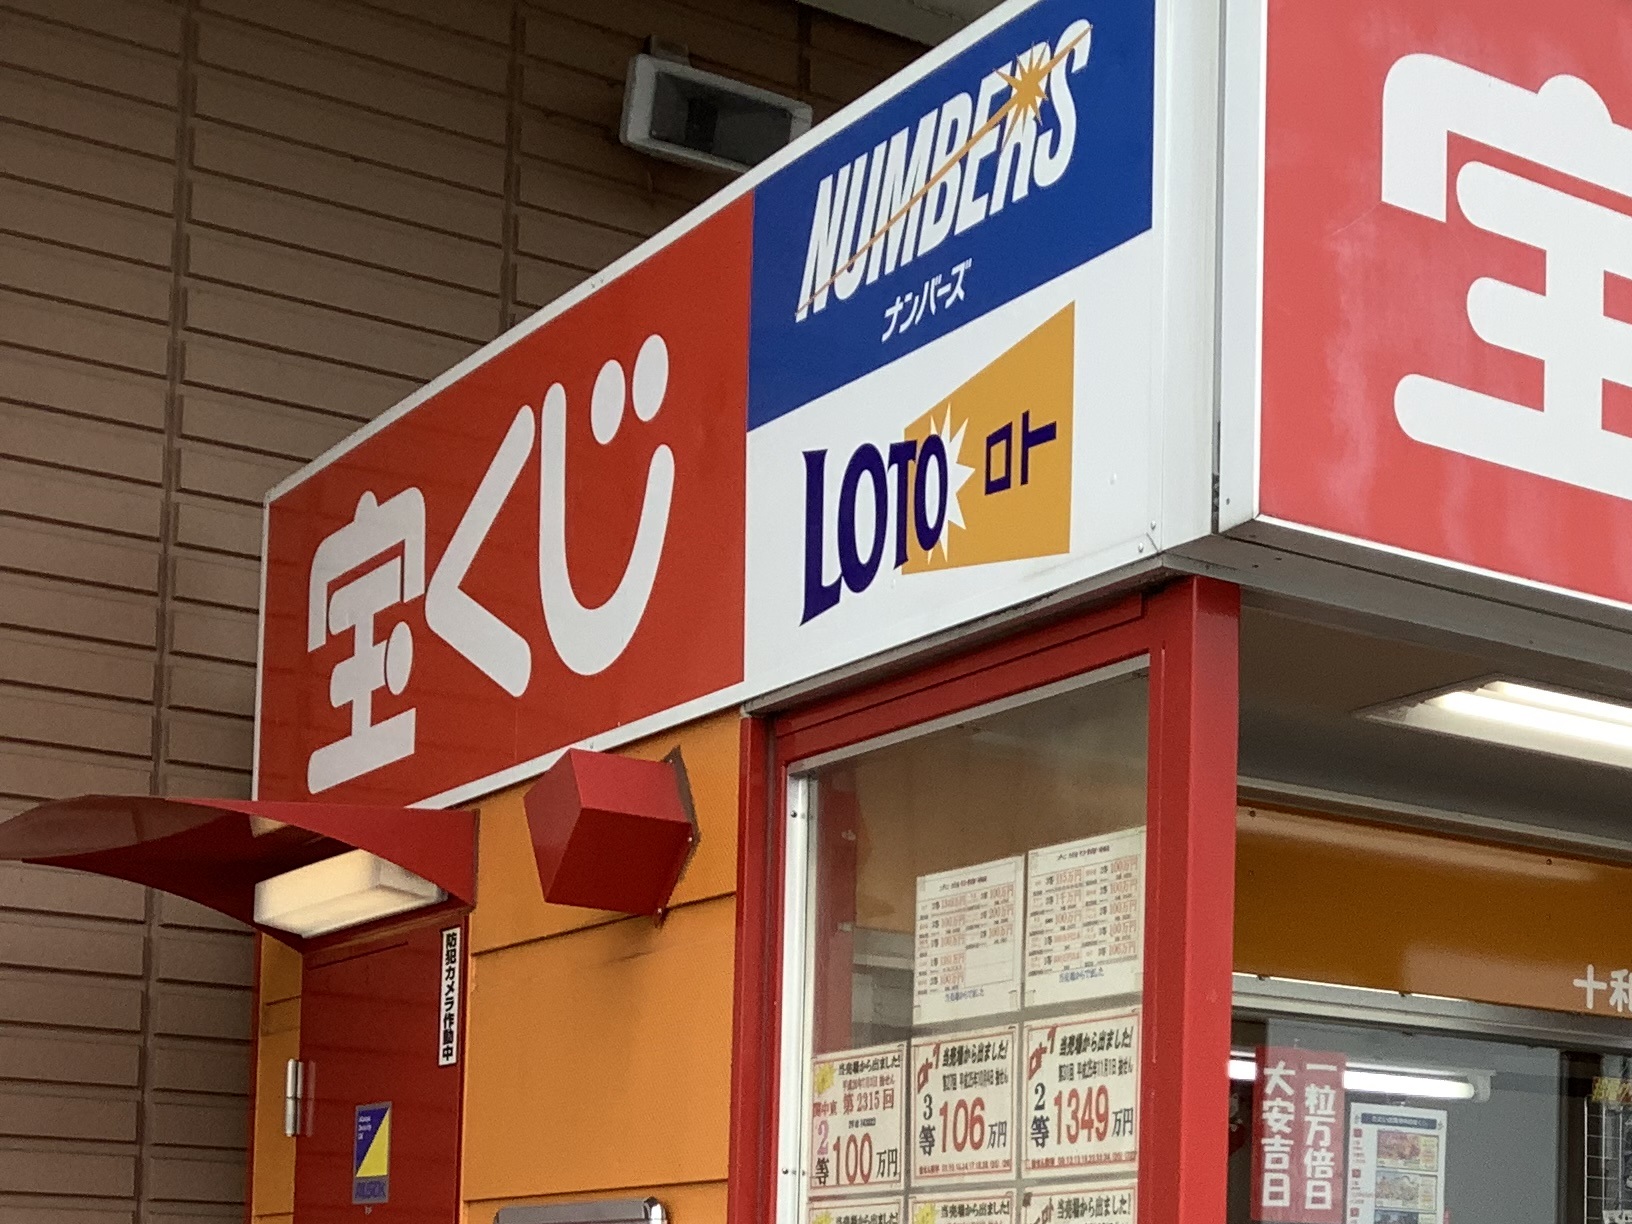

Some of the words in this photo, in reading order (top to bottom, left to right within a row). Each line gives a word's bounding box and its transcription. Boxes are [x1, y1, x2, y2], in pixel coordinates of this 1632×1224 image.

[795, 18, 1093, 322] NUMBERS
[881, 261, 972, 343] ナンバーズ
[984, 410, 1057, 497] ロト
[306, 334, 675, 794] 宝くじ
[801, 433, 948, 626] LOTO
[1260, 1060, 1297, 1209] 大安吉日
[1304, 1062, 1335, 1213] 一粒万倍日
